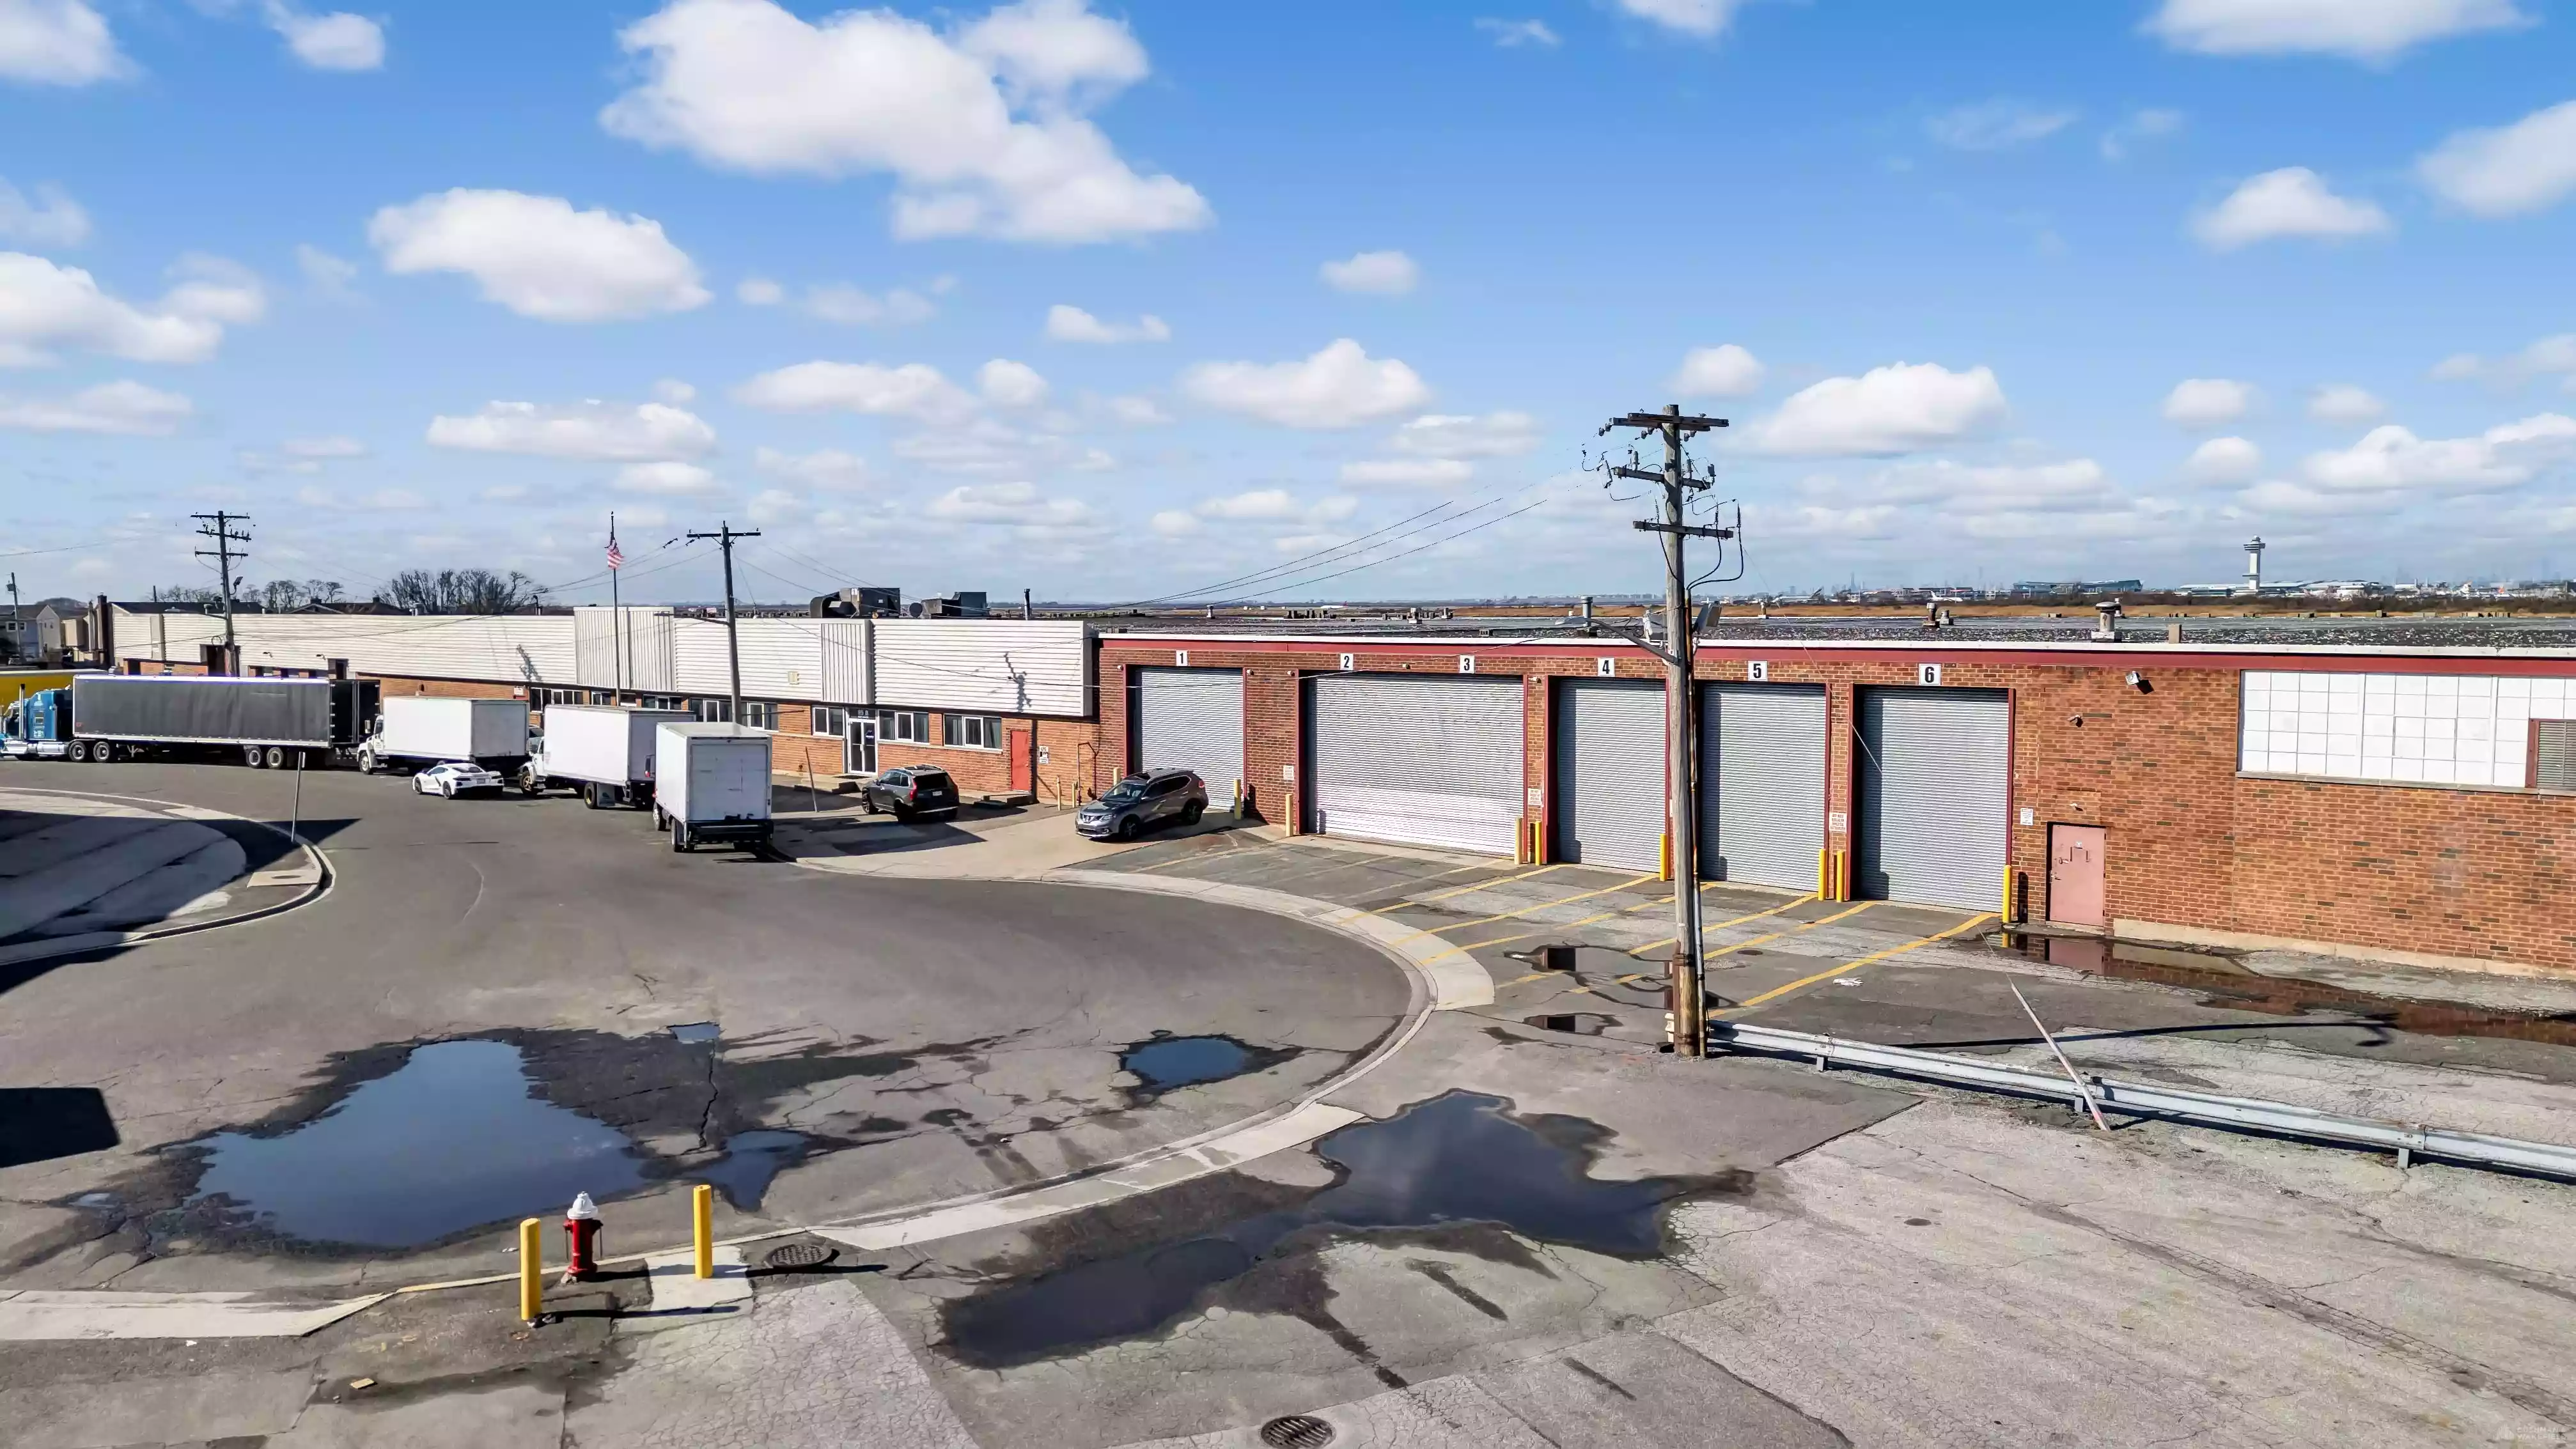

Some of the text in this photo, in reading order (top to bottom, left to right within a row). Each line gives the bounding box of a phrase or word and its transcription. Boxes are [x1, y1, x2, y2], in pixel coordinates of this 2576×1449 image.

[1180, 653, 1183, 664] 1
[1343, 656, 1350, 669] 2
[1464, 658, 1470, 671] 3
[1602, 660, 1610, 674] 4
[1753, 663, 1761, 679] 5
[1924, 666, 1935, 683] 6
